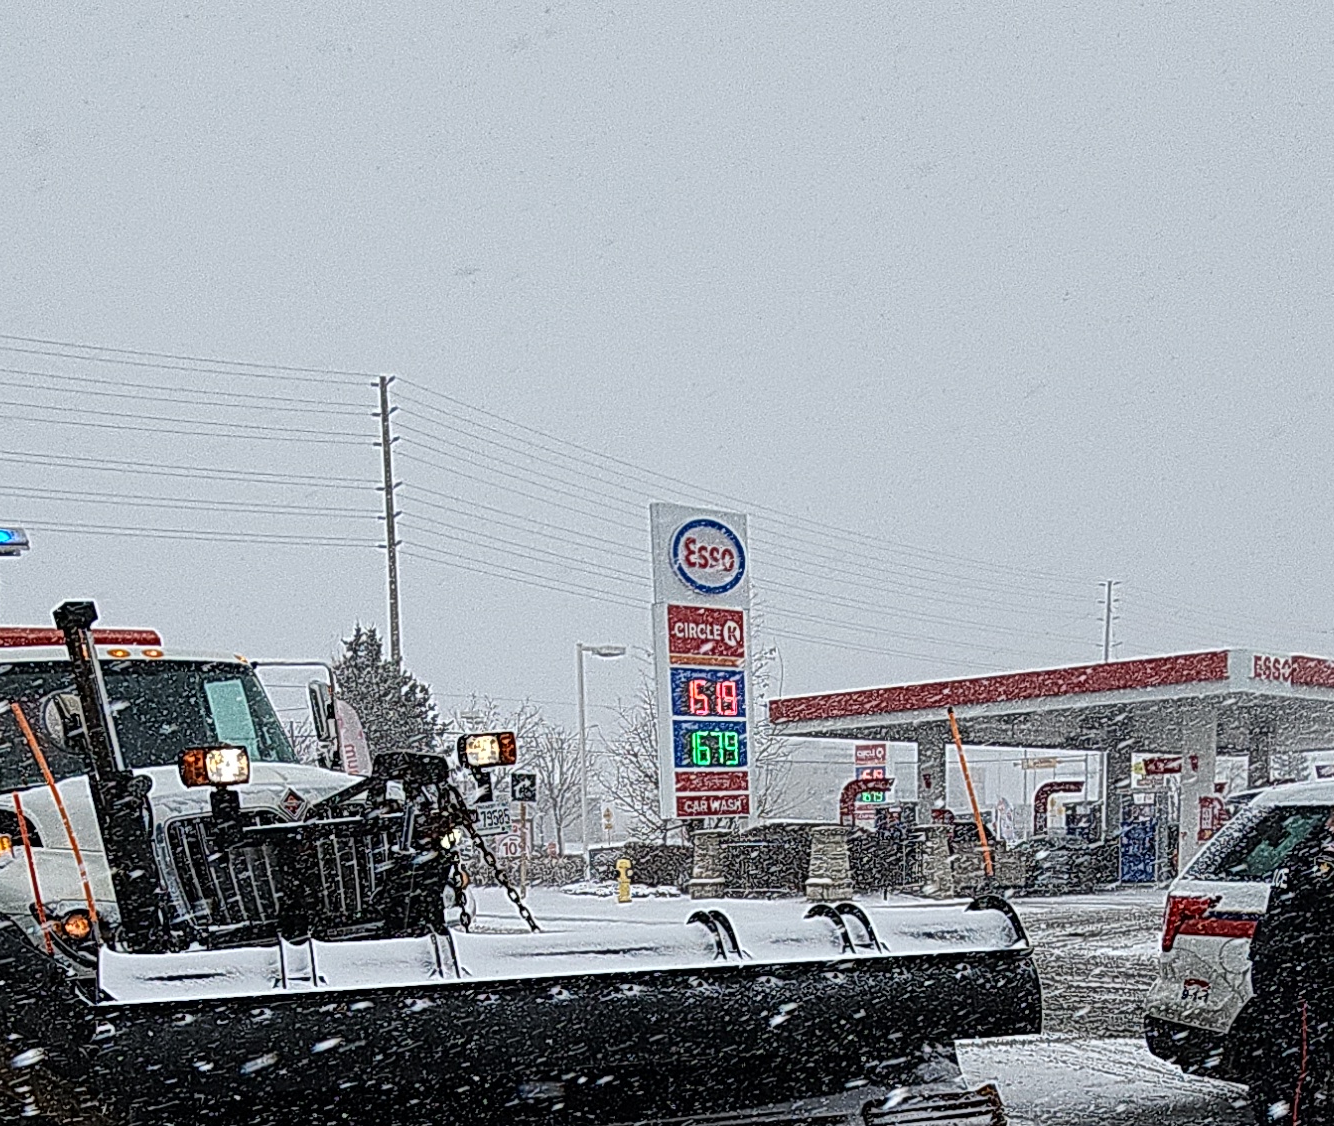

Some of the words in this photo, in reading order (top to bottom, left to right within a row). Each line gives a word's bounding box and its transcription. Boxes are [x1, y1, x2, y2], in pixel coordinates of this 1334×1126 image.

[674, 622, 722, 640] CIRCLE
[724, 621, 740, 646] K
[1253, 654, 1293, 682] ESSO
[692, 731, 739, 766] 1679
[684, 801, 709, 813] CAR
[709, 798, 742, 812] WASH
